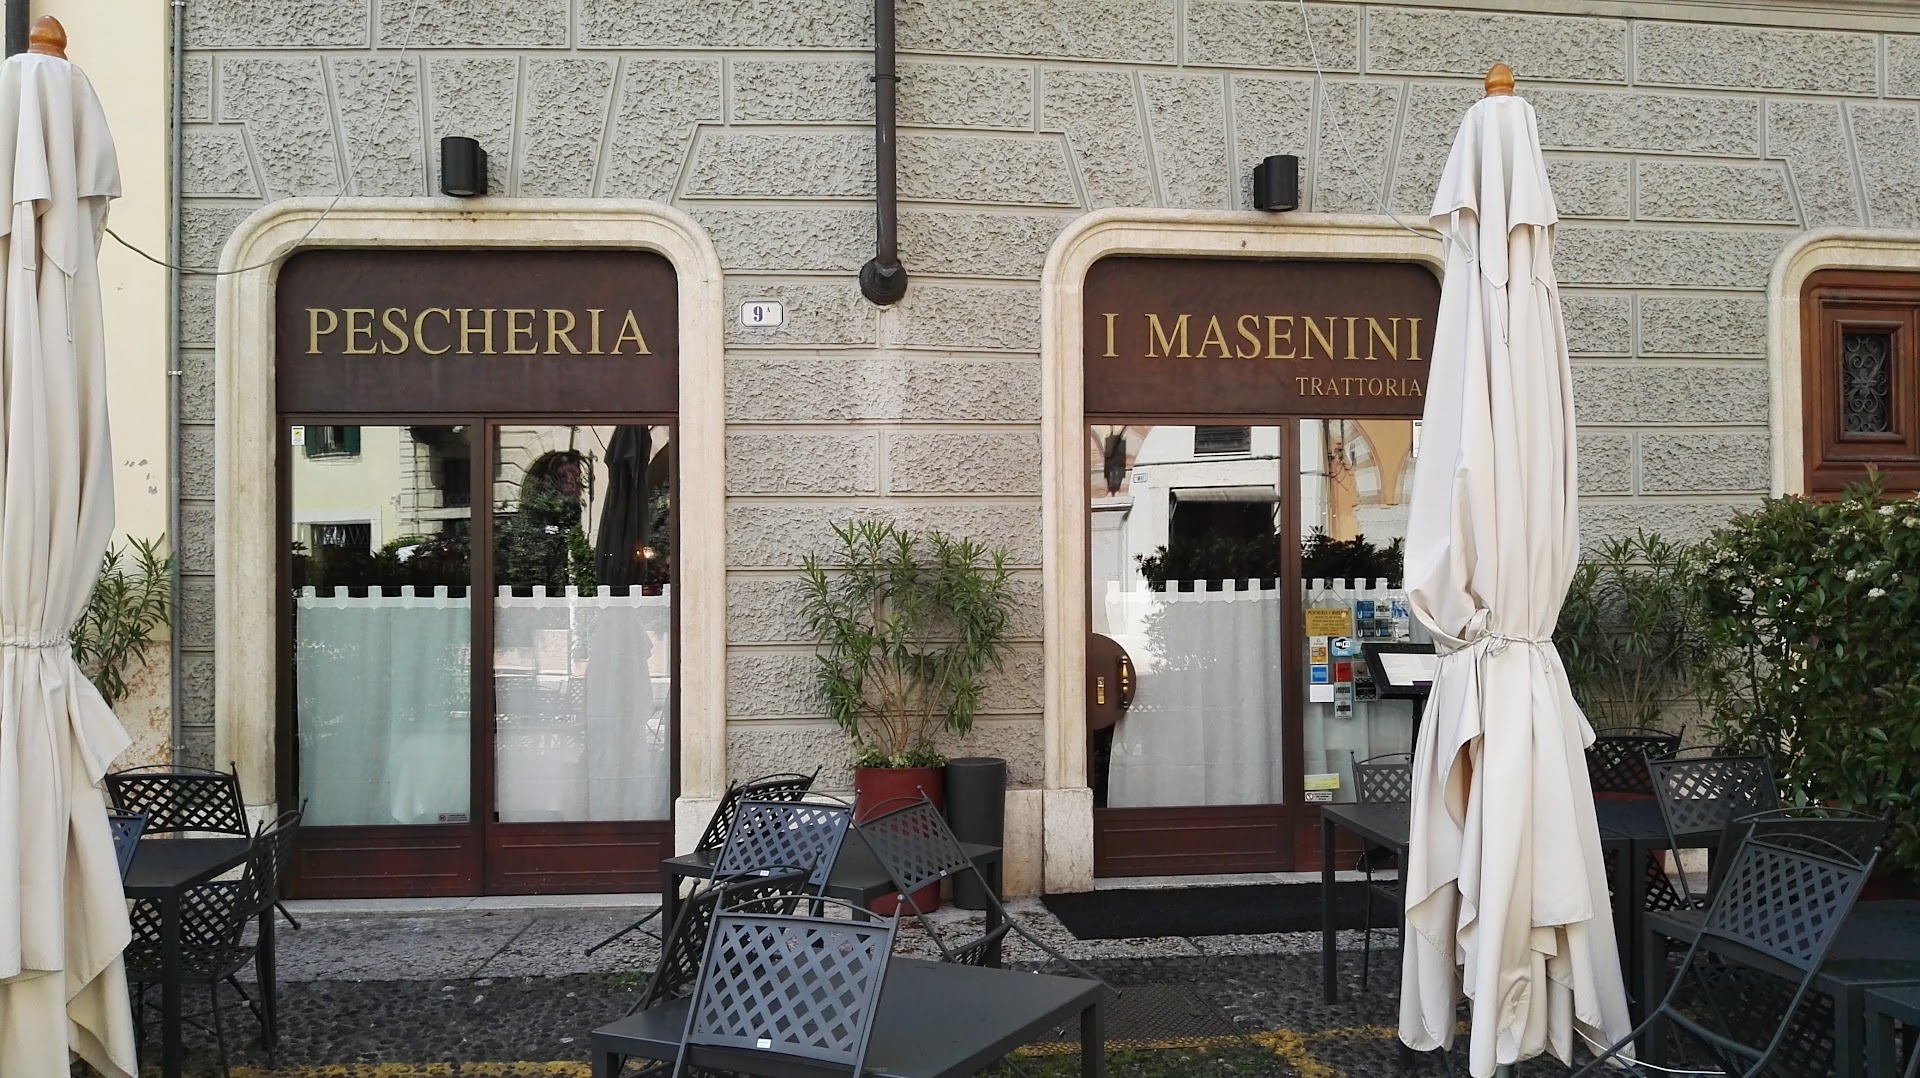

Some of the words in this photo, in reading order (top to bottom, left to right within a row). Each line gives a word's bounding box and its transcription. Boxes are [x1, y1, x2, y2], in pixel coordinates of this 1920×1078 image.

[305, 308, 652, 355] PESCHERIA
[1102, 313, 1119, 357] I
[1145, 313, 1423, 361] MASENINI
[1295, 377, 1423, 397] TRATTORIA
